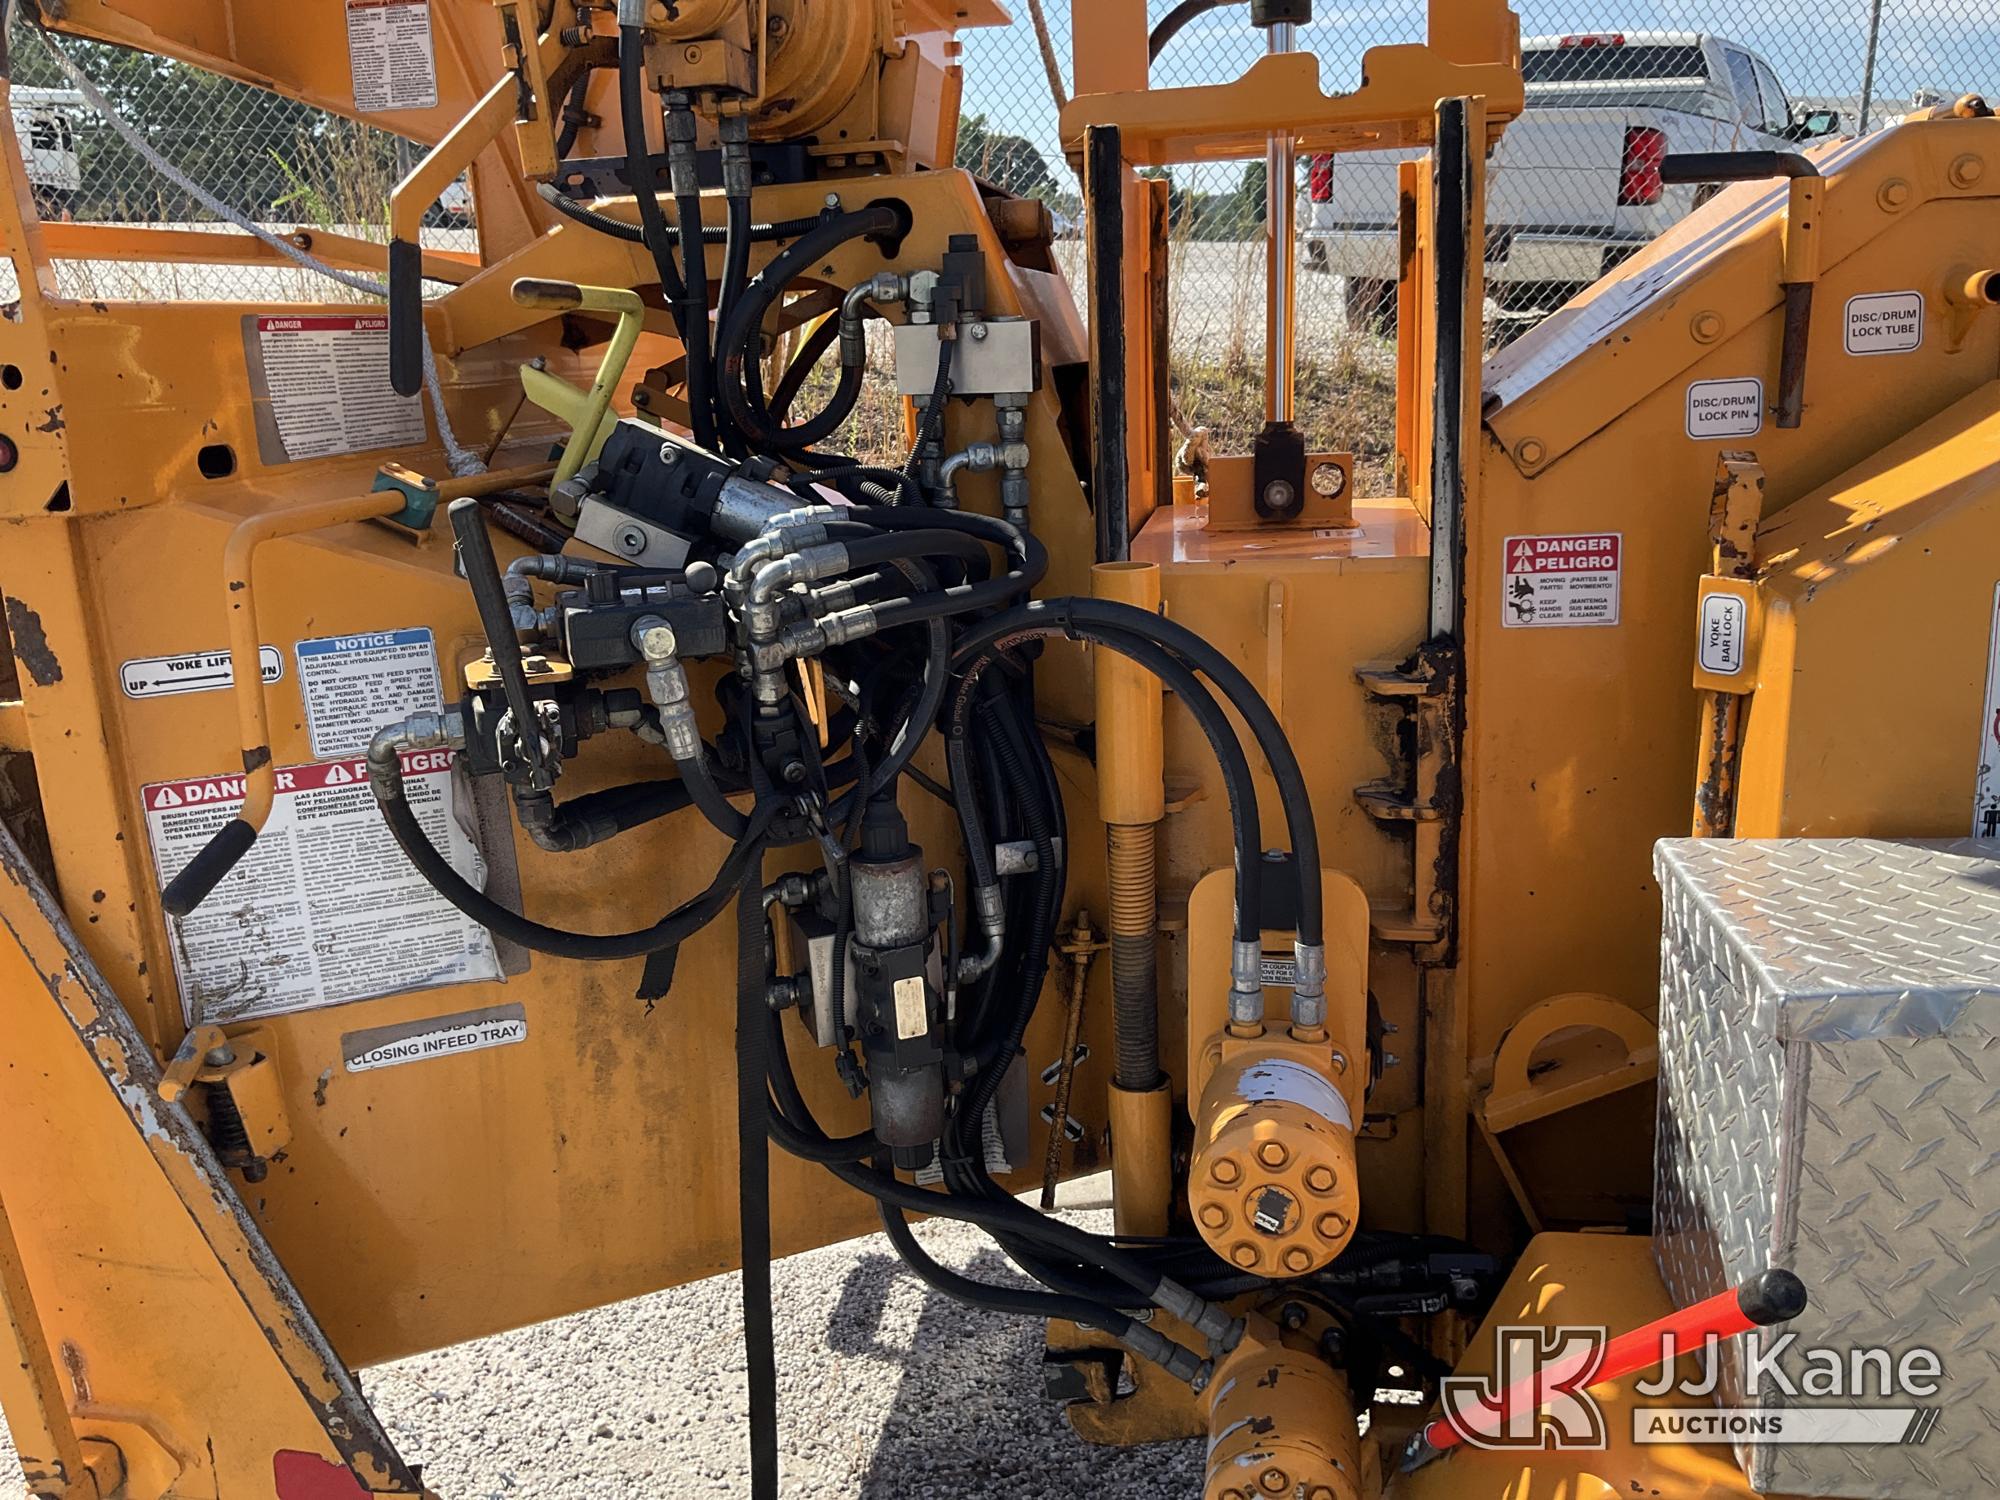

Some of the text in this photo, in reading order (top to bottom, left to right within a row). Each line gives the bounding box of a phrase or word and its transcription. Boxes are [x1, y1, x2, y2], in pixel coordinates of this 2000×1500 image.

[1851, 309, 1917, 323] DISC/DRUM
[274, 320, 302, 329] DANGER
[361, 320, 386, 328] PELIGRO
[1852, 324, 1915, 337] LOCK TUBE
[1692, 395, 1756, 408] DISC/DRUM
[1699, 409, 1749, 421] LOCK PIN
[1536, 538, 1612, 552] DANGER
[1535, 556, 1614, 570] PELIGRO
[1710, 618, 1720, 648] YOKE
[1721, 606, 1733, 663] BAR LOCK
[335, 635, 394, 650] NOTICE
[364, 648, 397, 656] EQUIPPED
[166, 659, 203, 672] YOKE
[305, 661, 348, 670] ADJUSTABLE
[350, 656, 388, 665] HYDRAULIC
[339, 675, 369, 683] OPERATE
[129, 681, 148, 691] UP
[330, 696, 367, 705] HYDRAULIC
[408, 688, 434, 696] DAMAGE
[335, 690, 364, 698] PERIODS
[330, 704, 367, 712] HYDRAULIC
[316, 720, 348, 729] DIAMETER
[338, 727, 373, 735] CONSTANT
[318, 737, 349, 745] CONTACT
[312, 785, 368, 799] ASTILLADORAS
[295, 799, 313, 807] MUY
[313, 793, 360, 804] PELIGROSAS
[161, 812, 188, 820] BRUSH
[189, 806, 227, 817] CHIPPERS
[297, 813, 317, 821] ESTE
[318, 805, 376, 818] AUTOADHESIVO
[162, 817, 209, 828] DANGEROUS
[202, 820, 223, 829] READ
[165, 833, 184, 841] THIS
[423, 1034, 477, 1052] INFEED
[481, 1025, 519, 1042] TRAY
